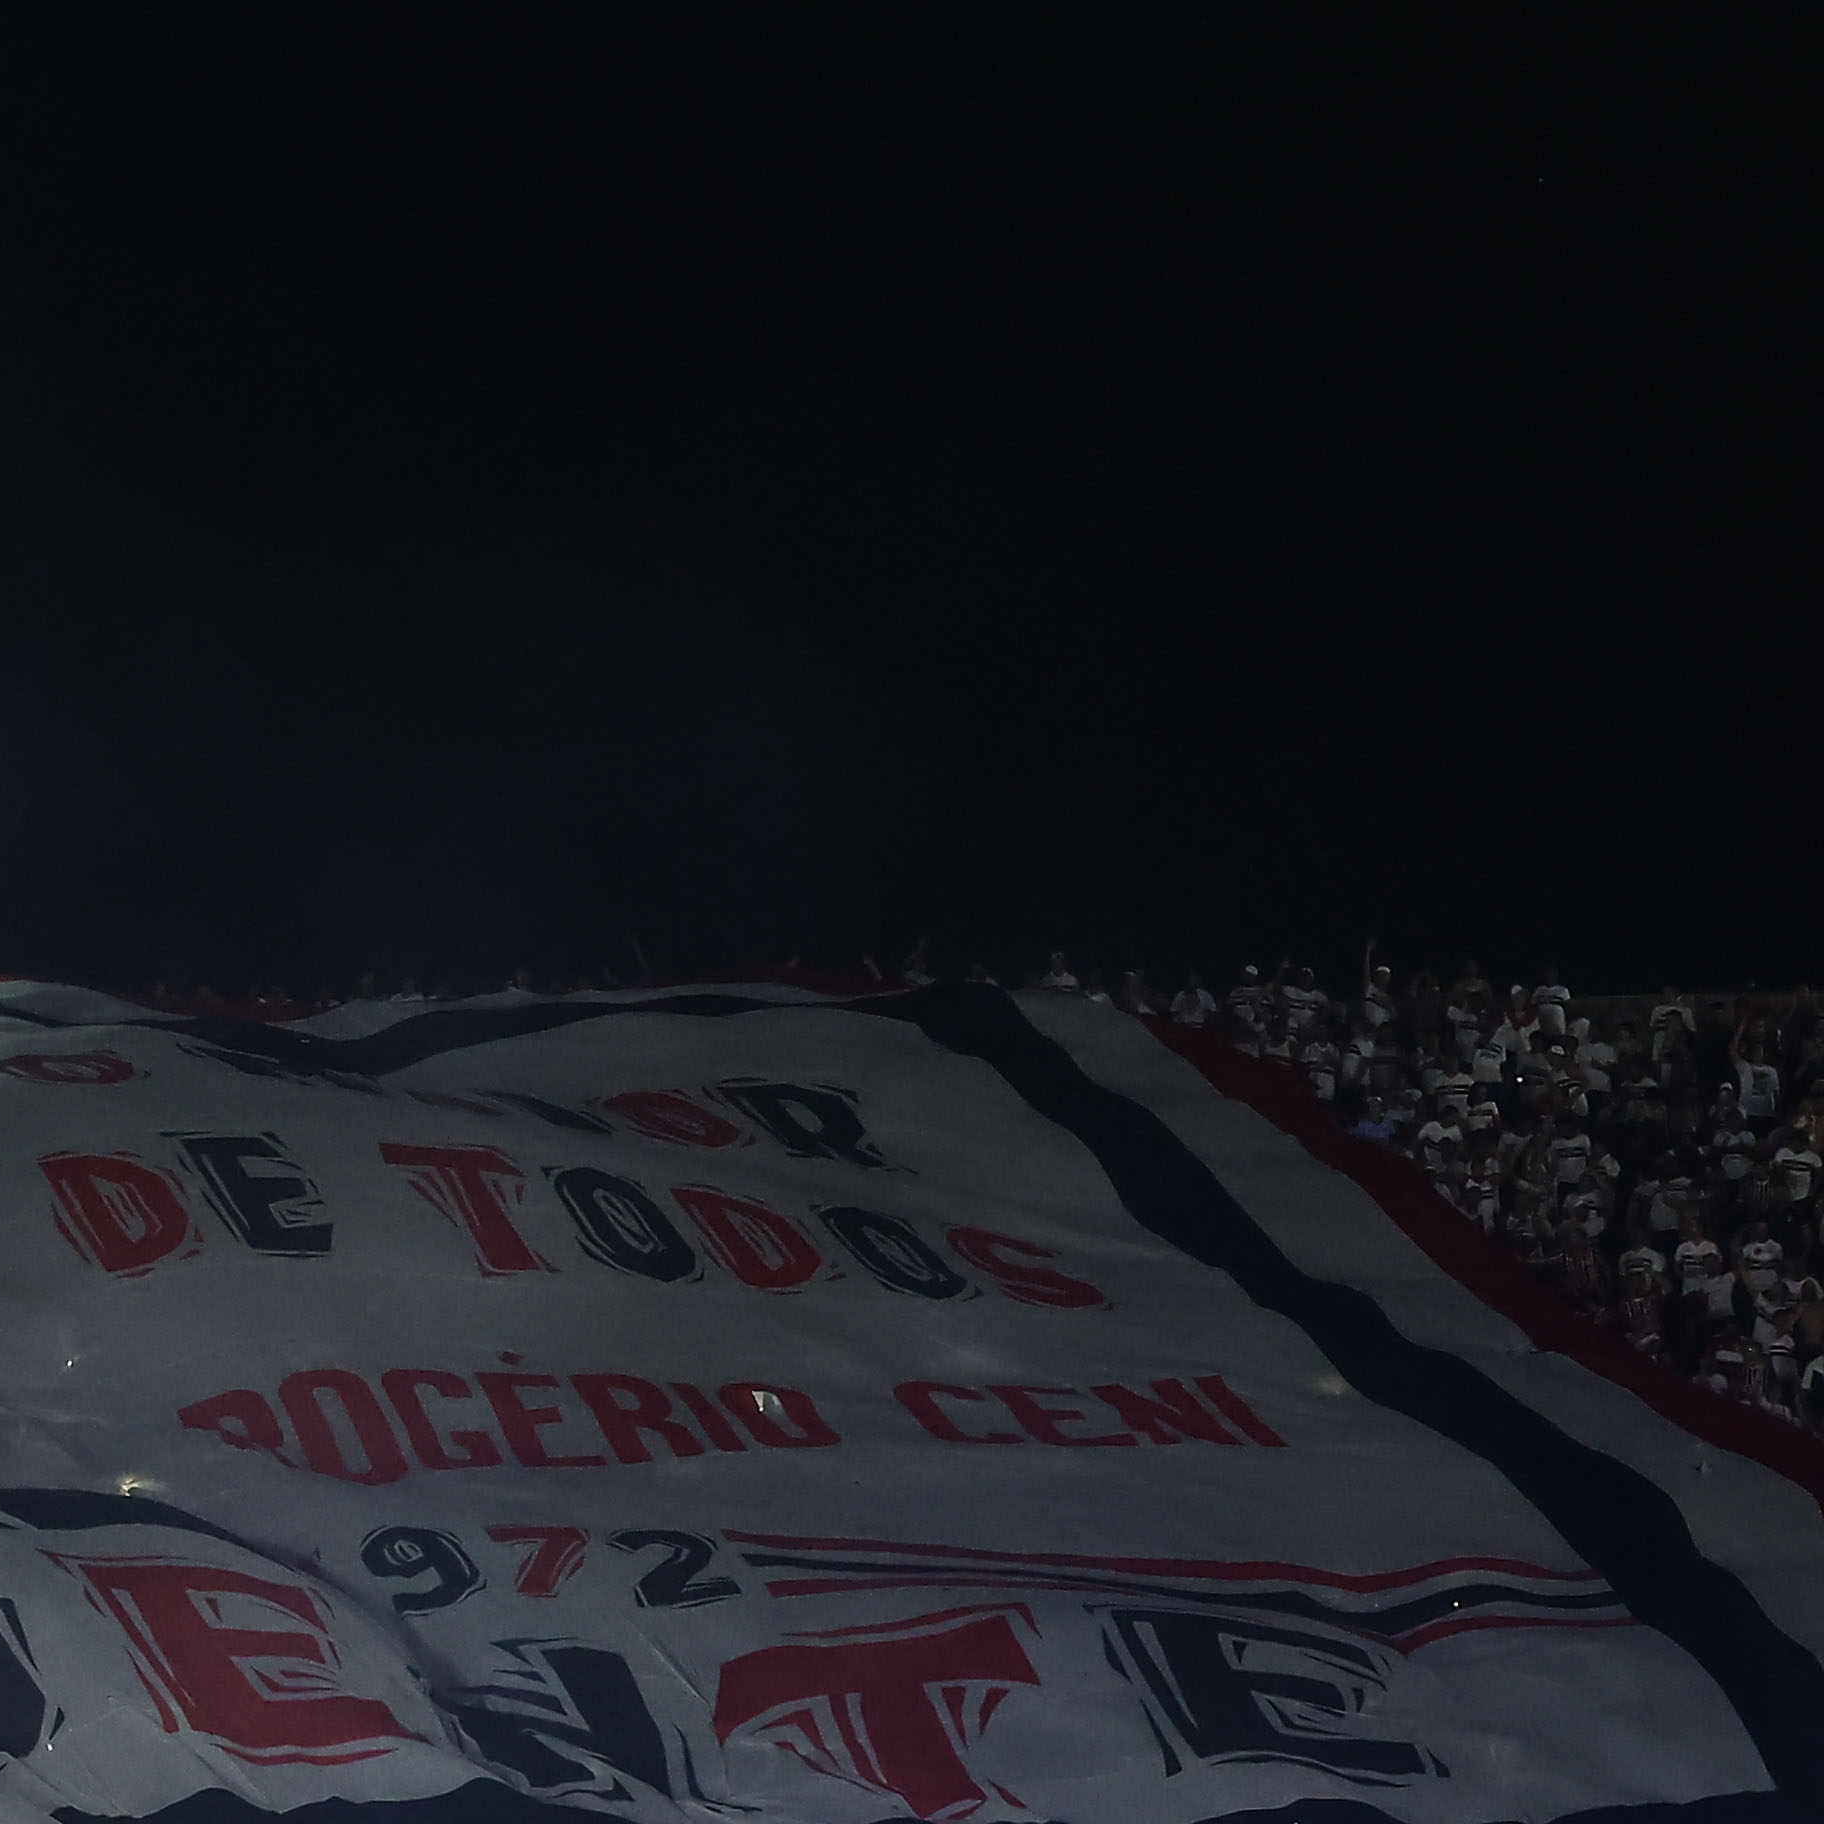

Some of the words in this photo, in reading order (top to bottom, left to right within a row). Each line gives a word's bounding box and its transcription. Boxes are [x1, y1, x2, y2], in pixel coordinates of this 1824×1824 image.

[36, 1130, 334, 1278] DE
[378, 1140, 1114, 1312] TODOS
[178, 1352, 843, 1485] ROGÉRIO
[890, 1373, 1290, 1450] CENI
